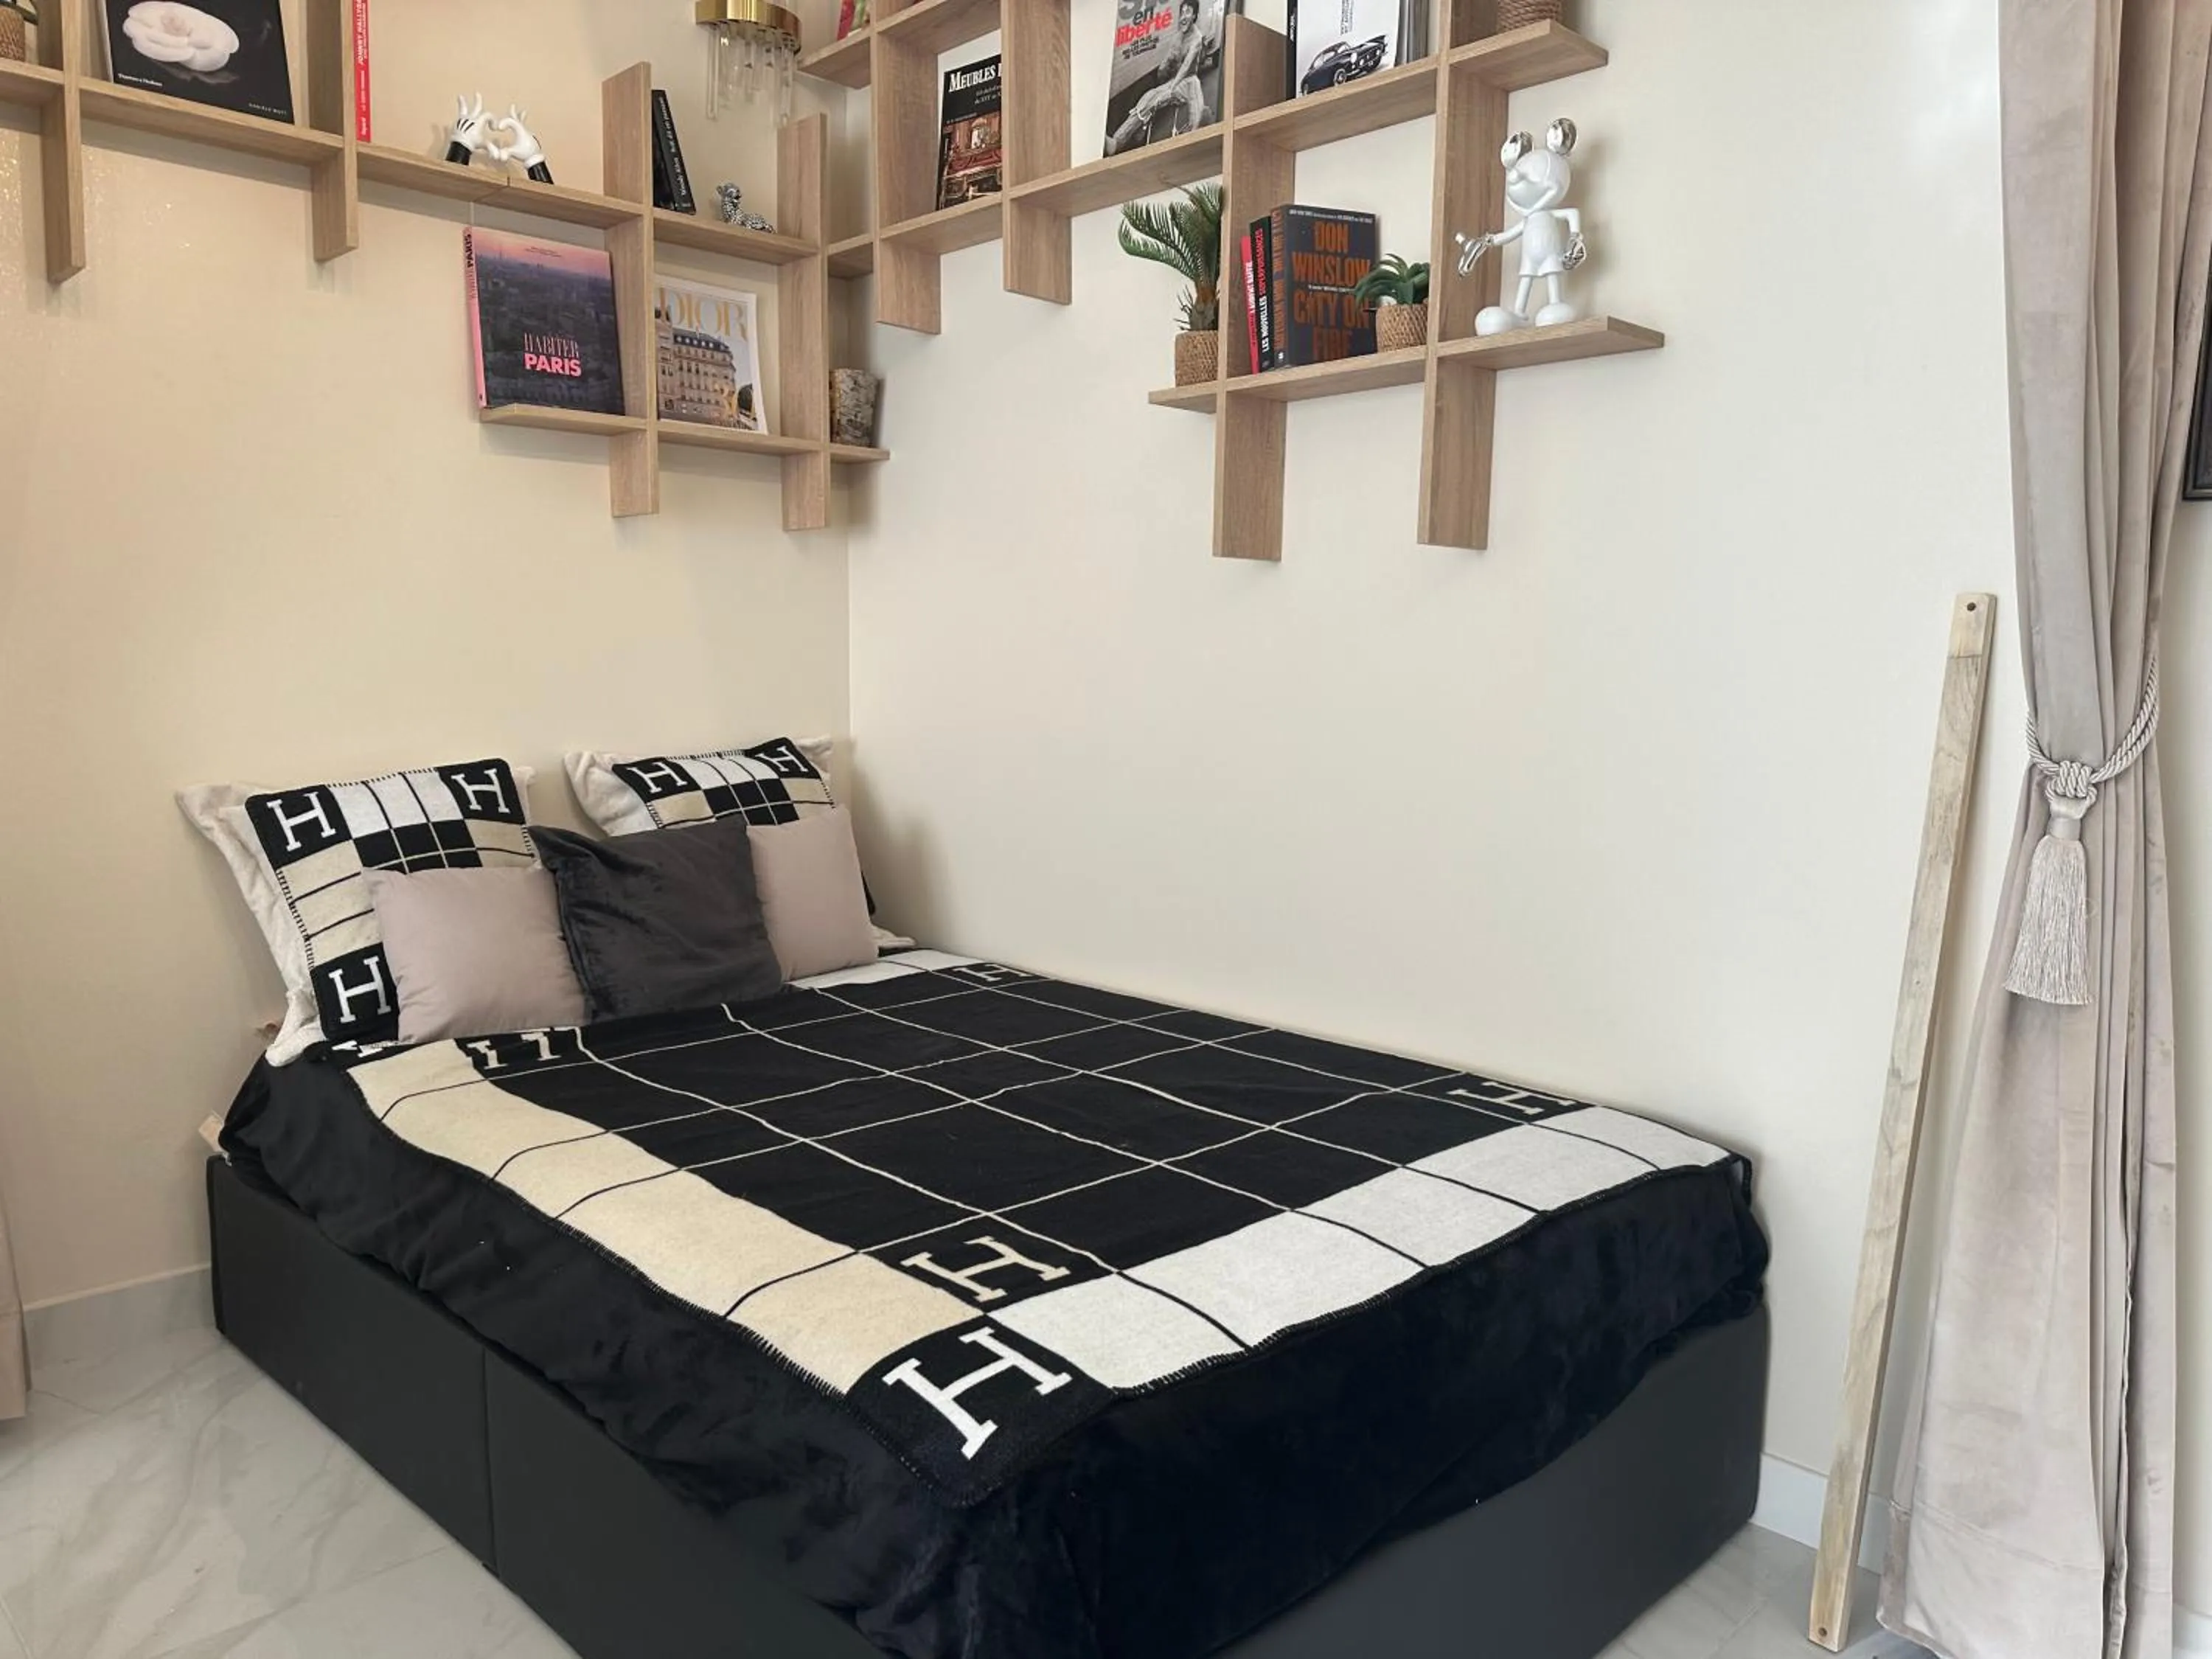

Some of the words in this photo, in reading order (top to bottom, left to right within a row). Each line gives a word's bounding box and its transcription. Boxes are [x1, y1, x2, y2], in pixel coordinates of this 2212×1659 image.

[1116, 6, 1172, 47] liberté
[1133, 6, 1154, 26] en
[1315, 221, 1349, 253] DON
[1293, 251, 1371, 286] WINSLOW
[659, 287, 748, 342] DIOR
[1259, 296, 1270, 337] NOUVELLES
[524, 333, 580, 359] HABITER
[1262, 335, 1270, 353] LES
[524, 352, 582, 377] PARIS
[755, 745, 809, 773] H
[451, 768, 511, 814] H
[627, 762, 688, 793] H
[266, 791, 336, 852] H
[328, 956, 392, 1023] H
[1446, 1081, 1577, 1115] H
[900, 1235, 1071, 1303] H
[881, 1326, 1073, 1460] H
